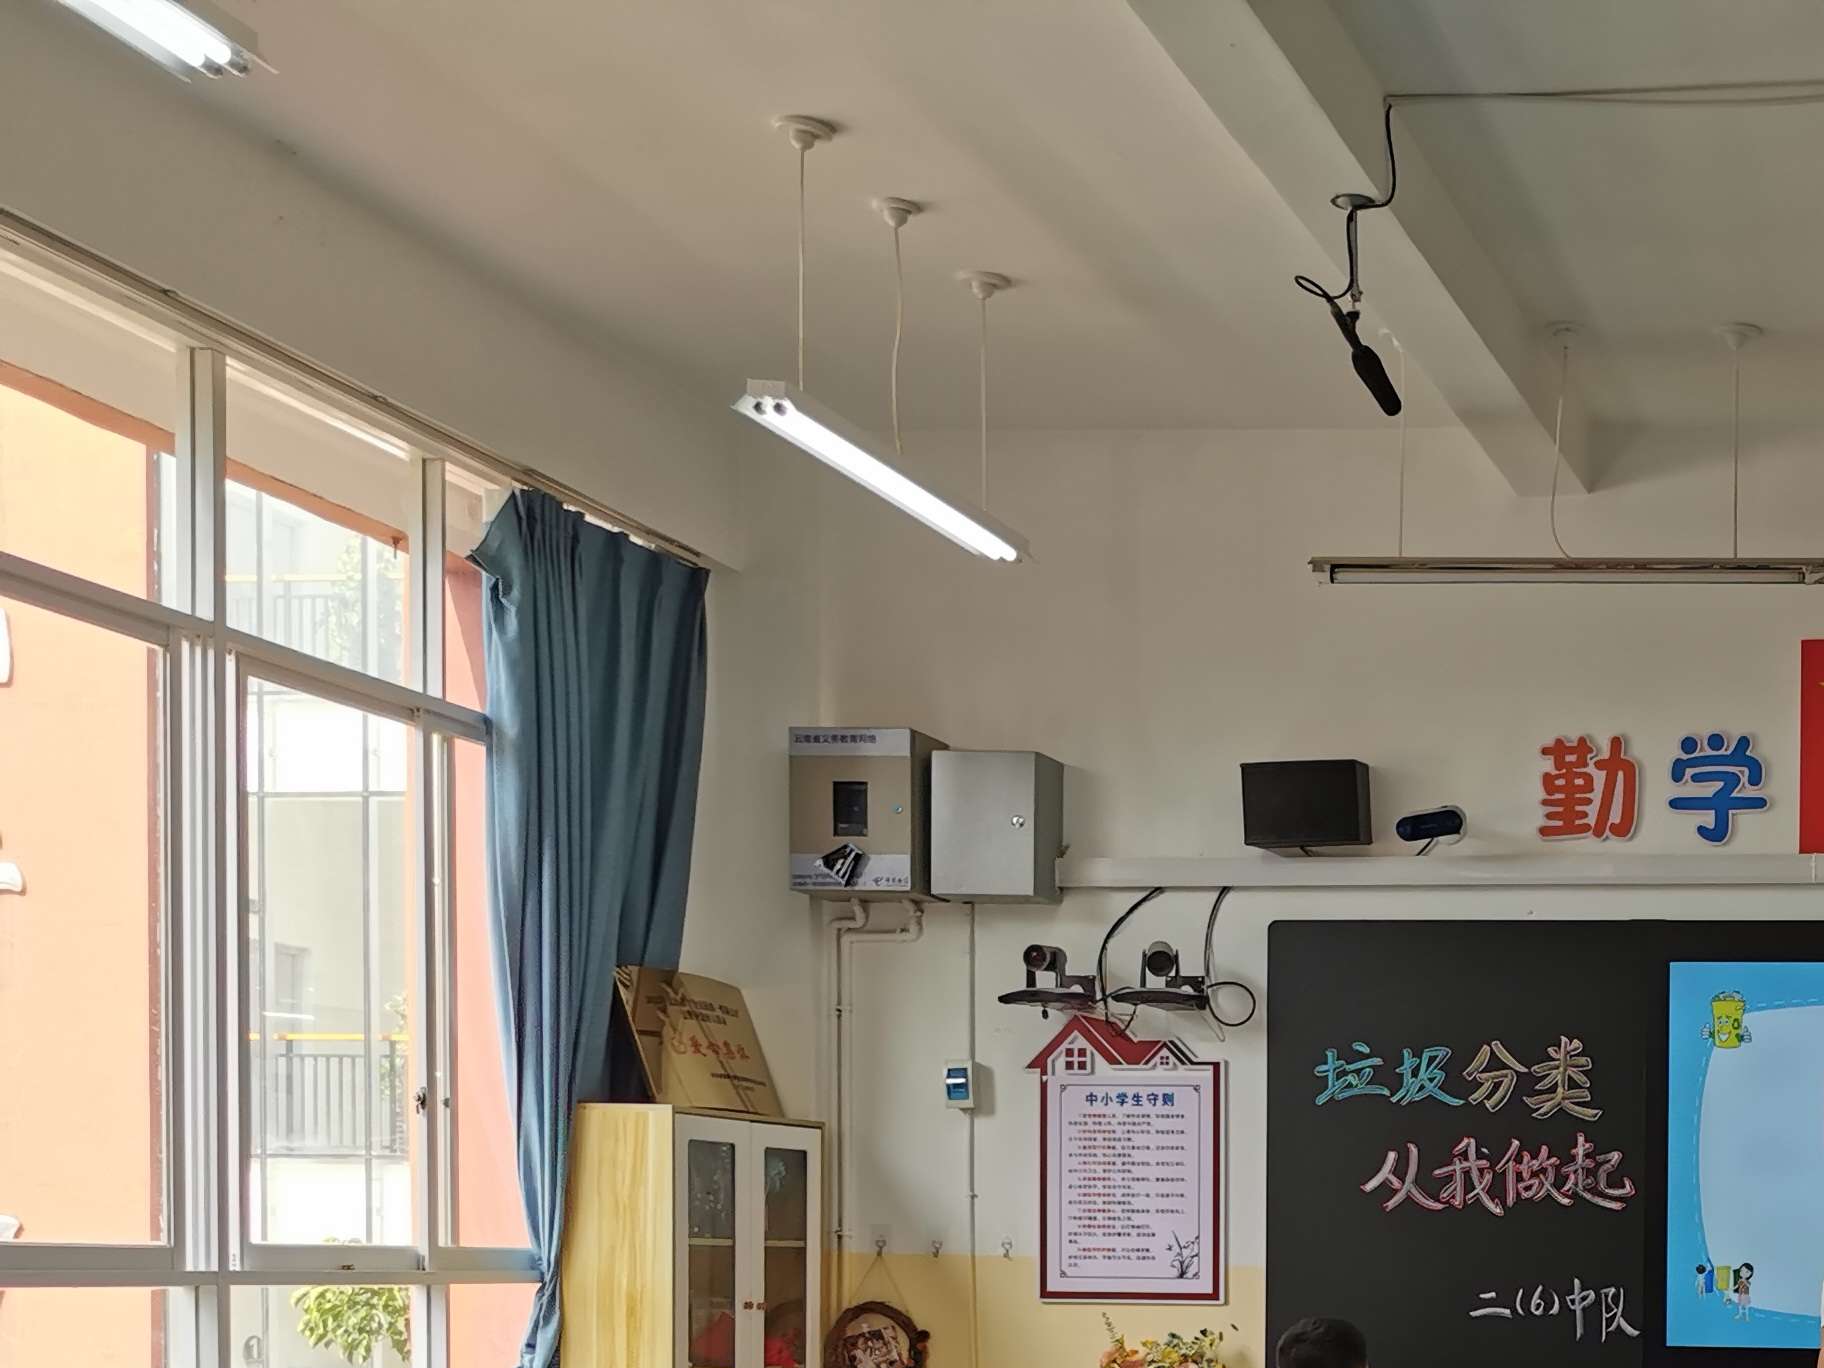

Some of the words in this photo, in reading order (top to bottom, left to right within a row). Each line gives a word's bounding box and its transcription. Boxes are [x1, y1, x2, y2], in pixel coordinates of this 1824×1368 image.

[1536, 731, 1769, 844] 勤学
[1085, 1091, 1175, 1107] 中小学生守则
[1314, 1035, 1603, 1121] 垃圾分类
[1360, 1133, 1637, 1216] 从我做起
